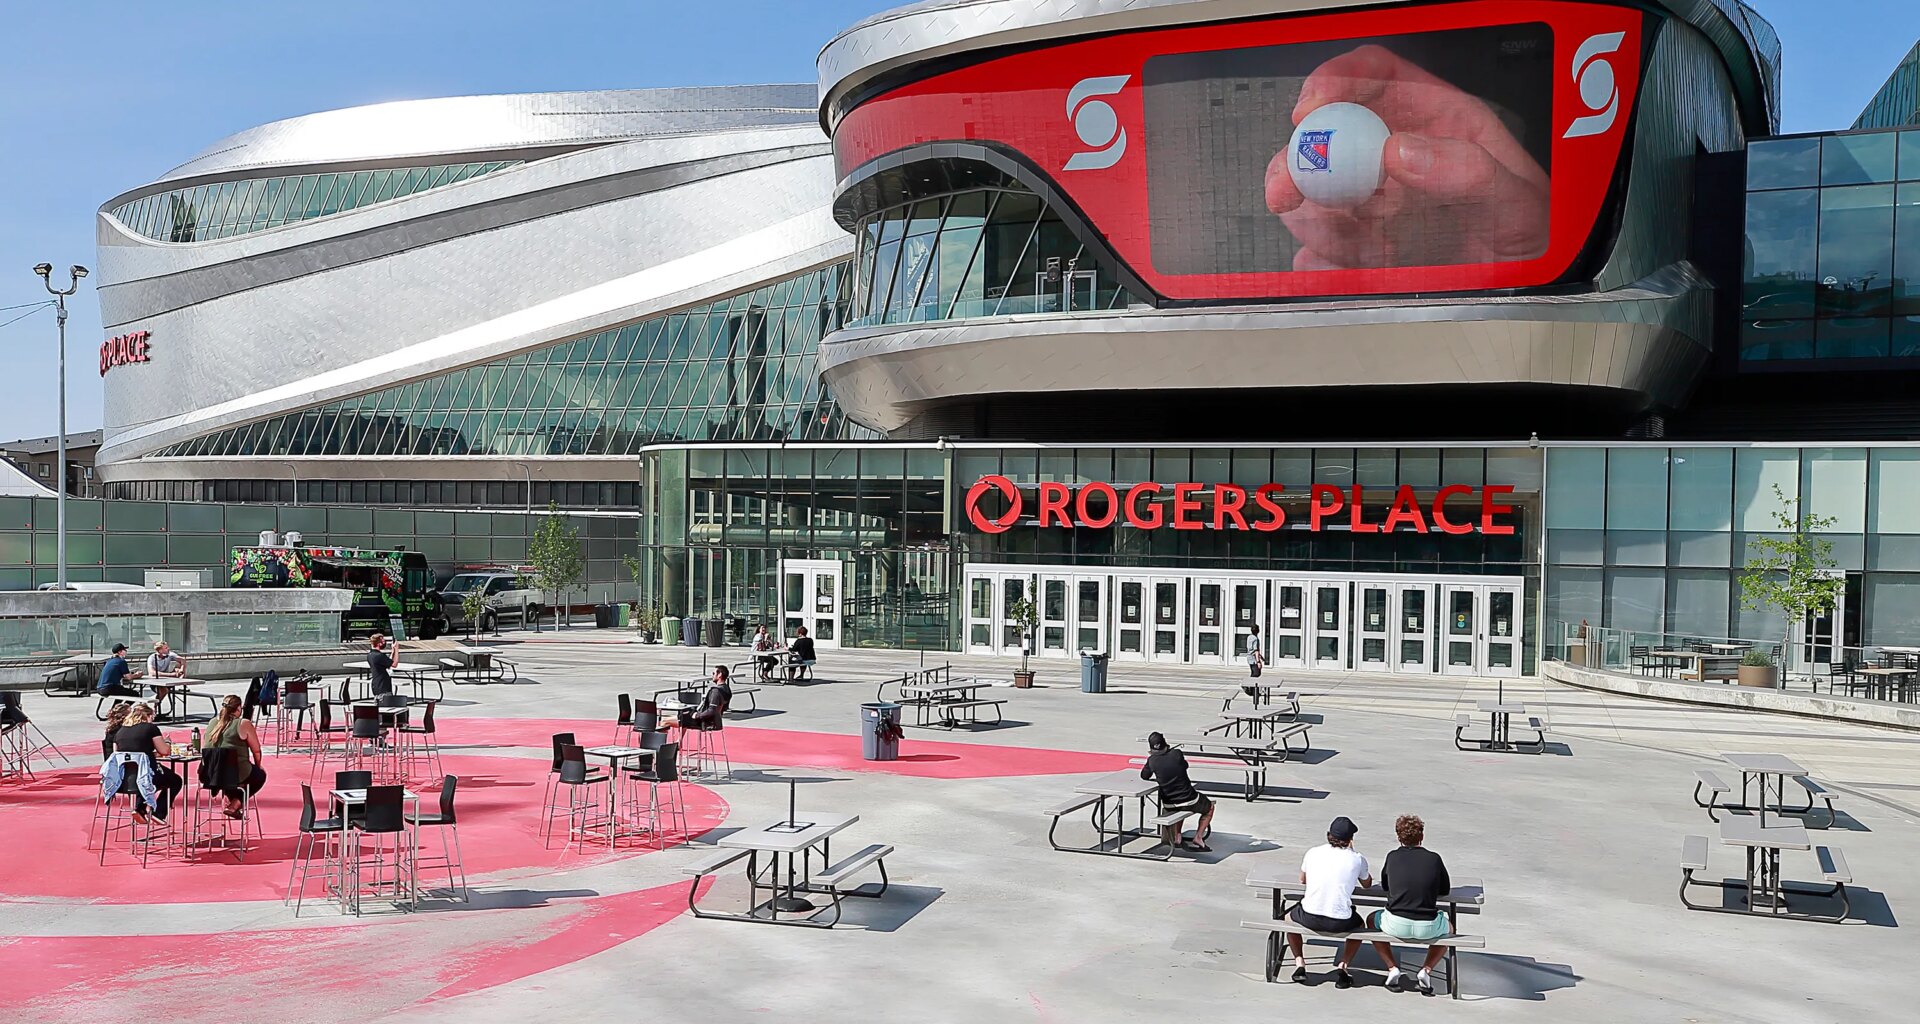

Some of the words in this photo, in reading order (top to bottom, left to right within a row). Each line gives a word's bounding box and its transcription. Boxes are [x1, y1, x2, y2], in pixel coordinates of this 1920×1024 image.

[1300, 135, 1311, 143] NEW
[1312, 134, 1328, 142] YORK
[1302, 144, 1326, 167] RANGERS
[108, 331, 149, 367] PLACE
[1039, 482, 1286, 532] ROGERS
[1311, 484, 1515, 535] PLACE
